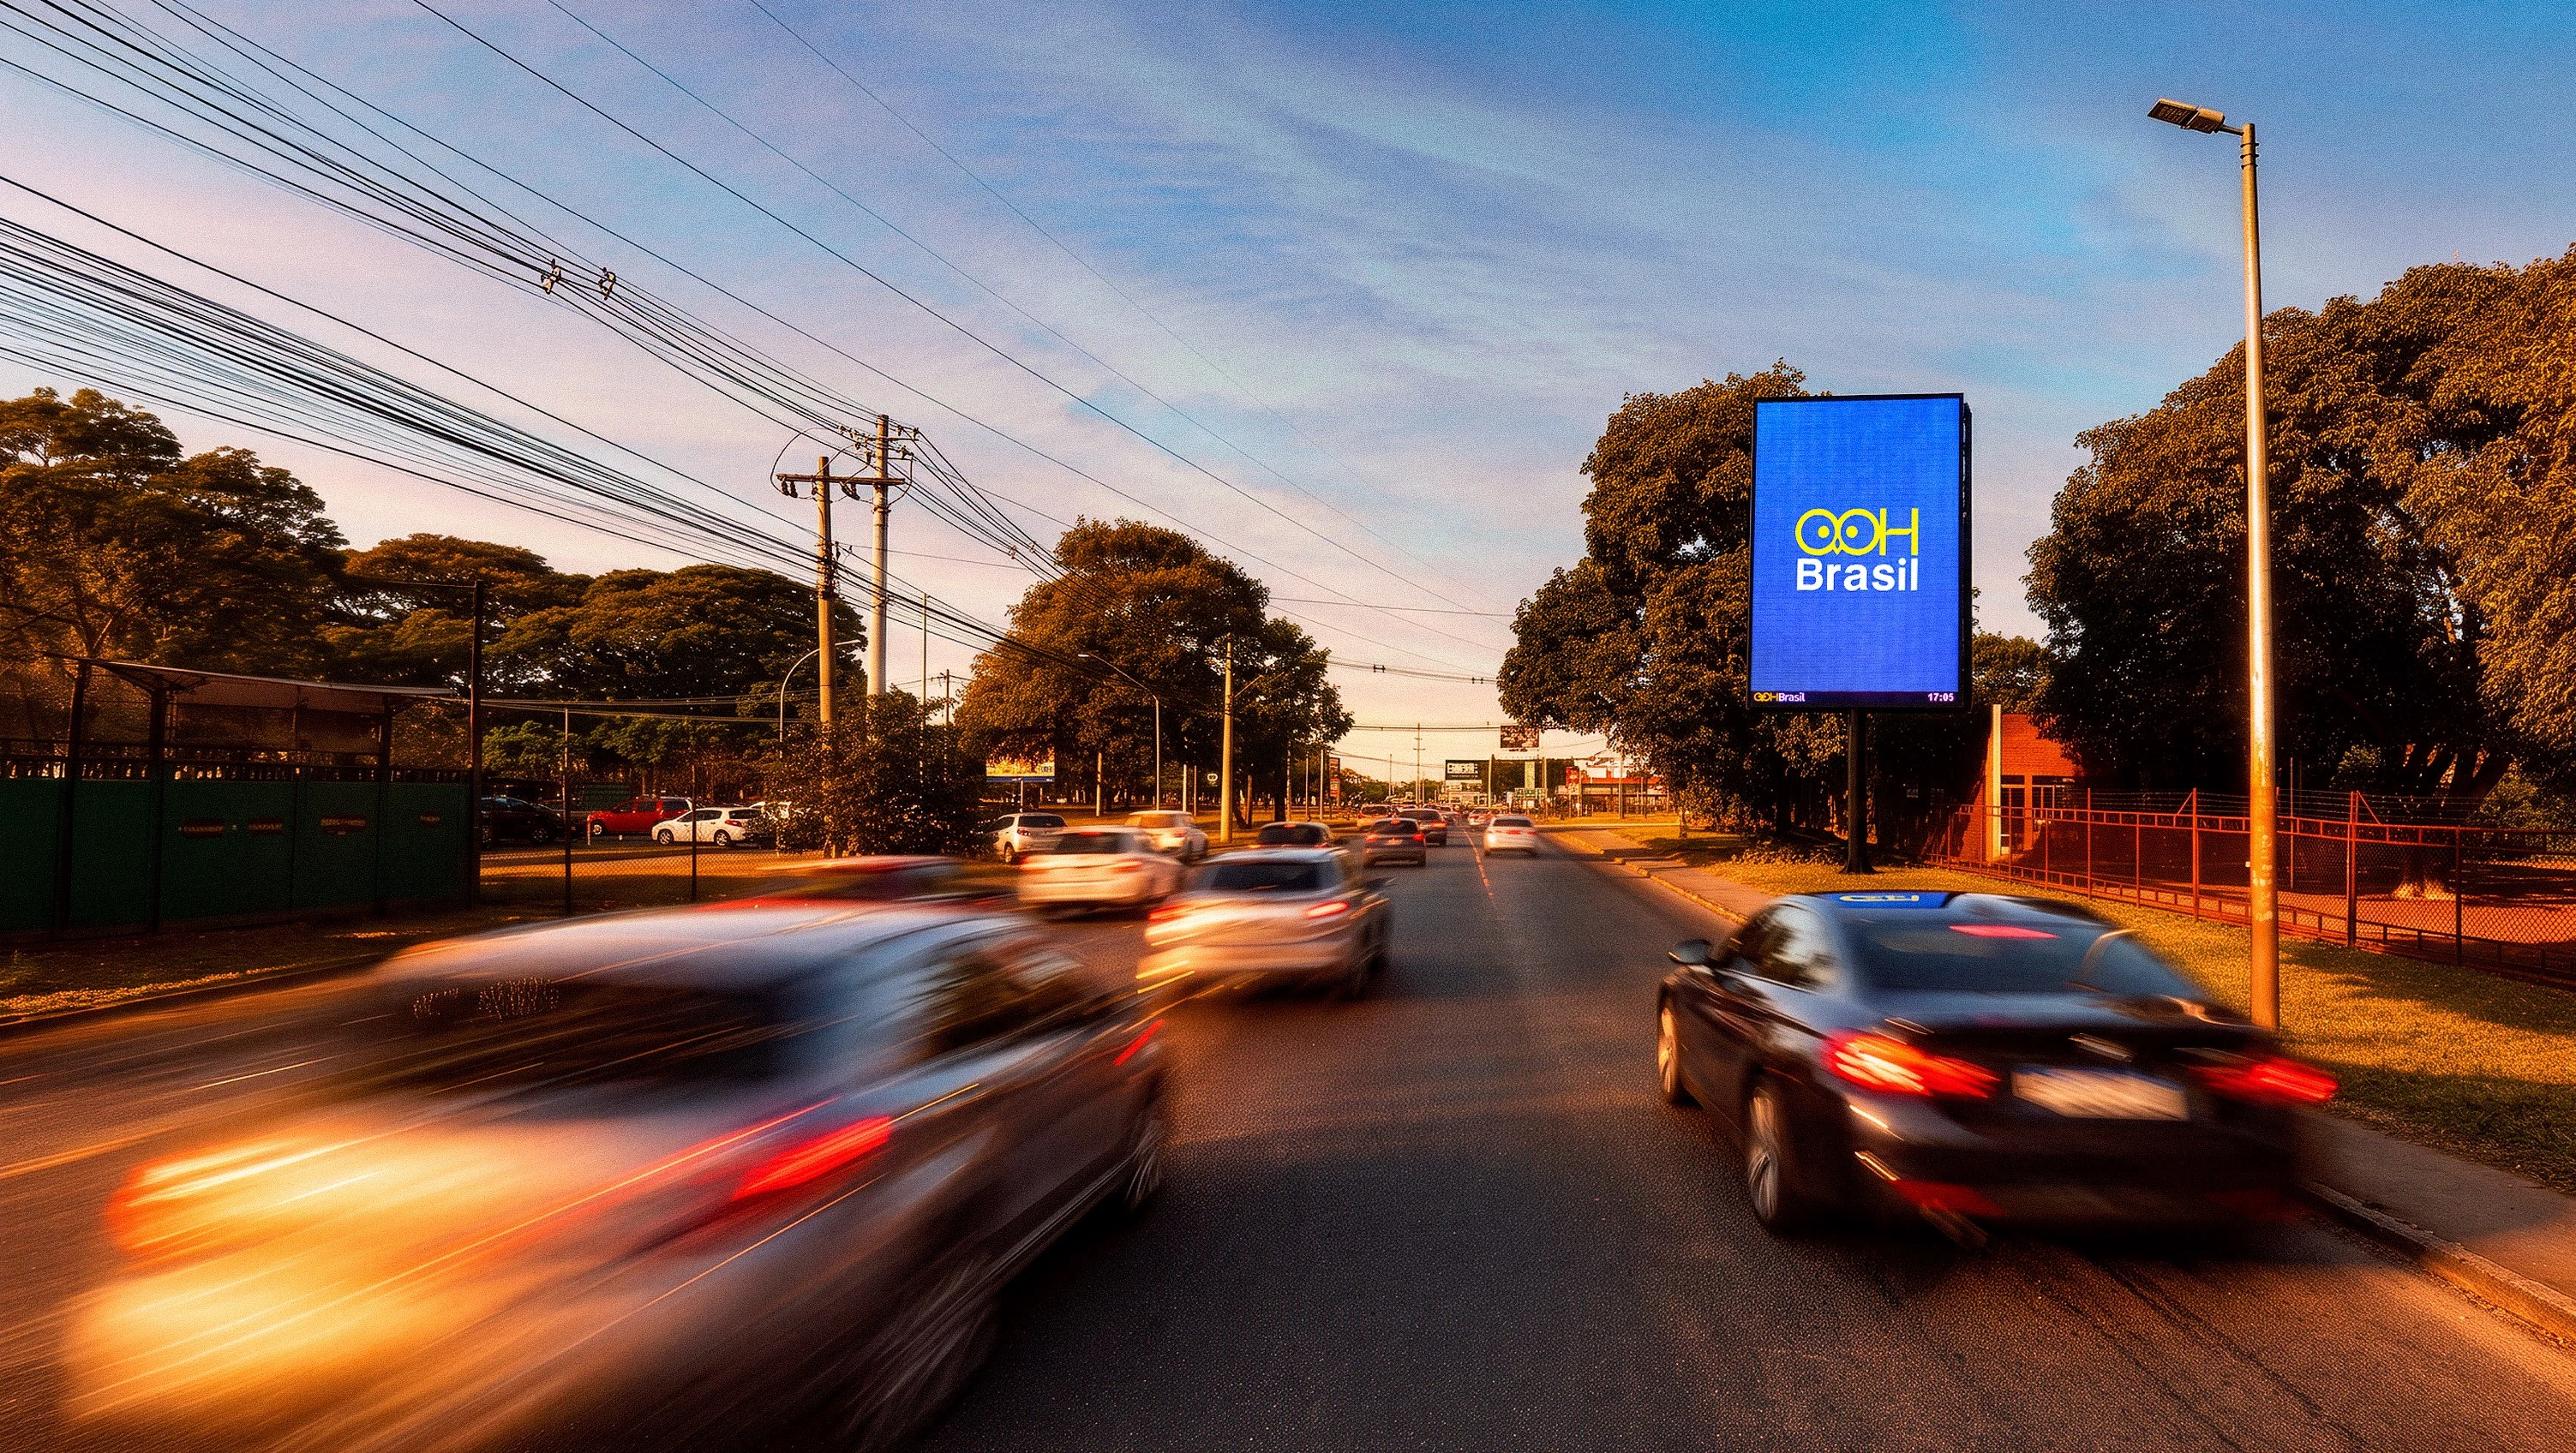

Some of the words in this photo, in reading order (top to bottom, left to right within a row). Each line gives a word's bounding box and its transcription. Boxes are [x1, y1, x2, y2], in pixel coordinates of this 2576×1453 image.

[1795, 508, 1919, 556] OOH
[1797, 558, 1919, 591] Brasil
[1927, 692, 1955, 702] 17:05
